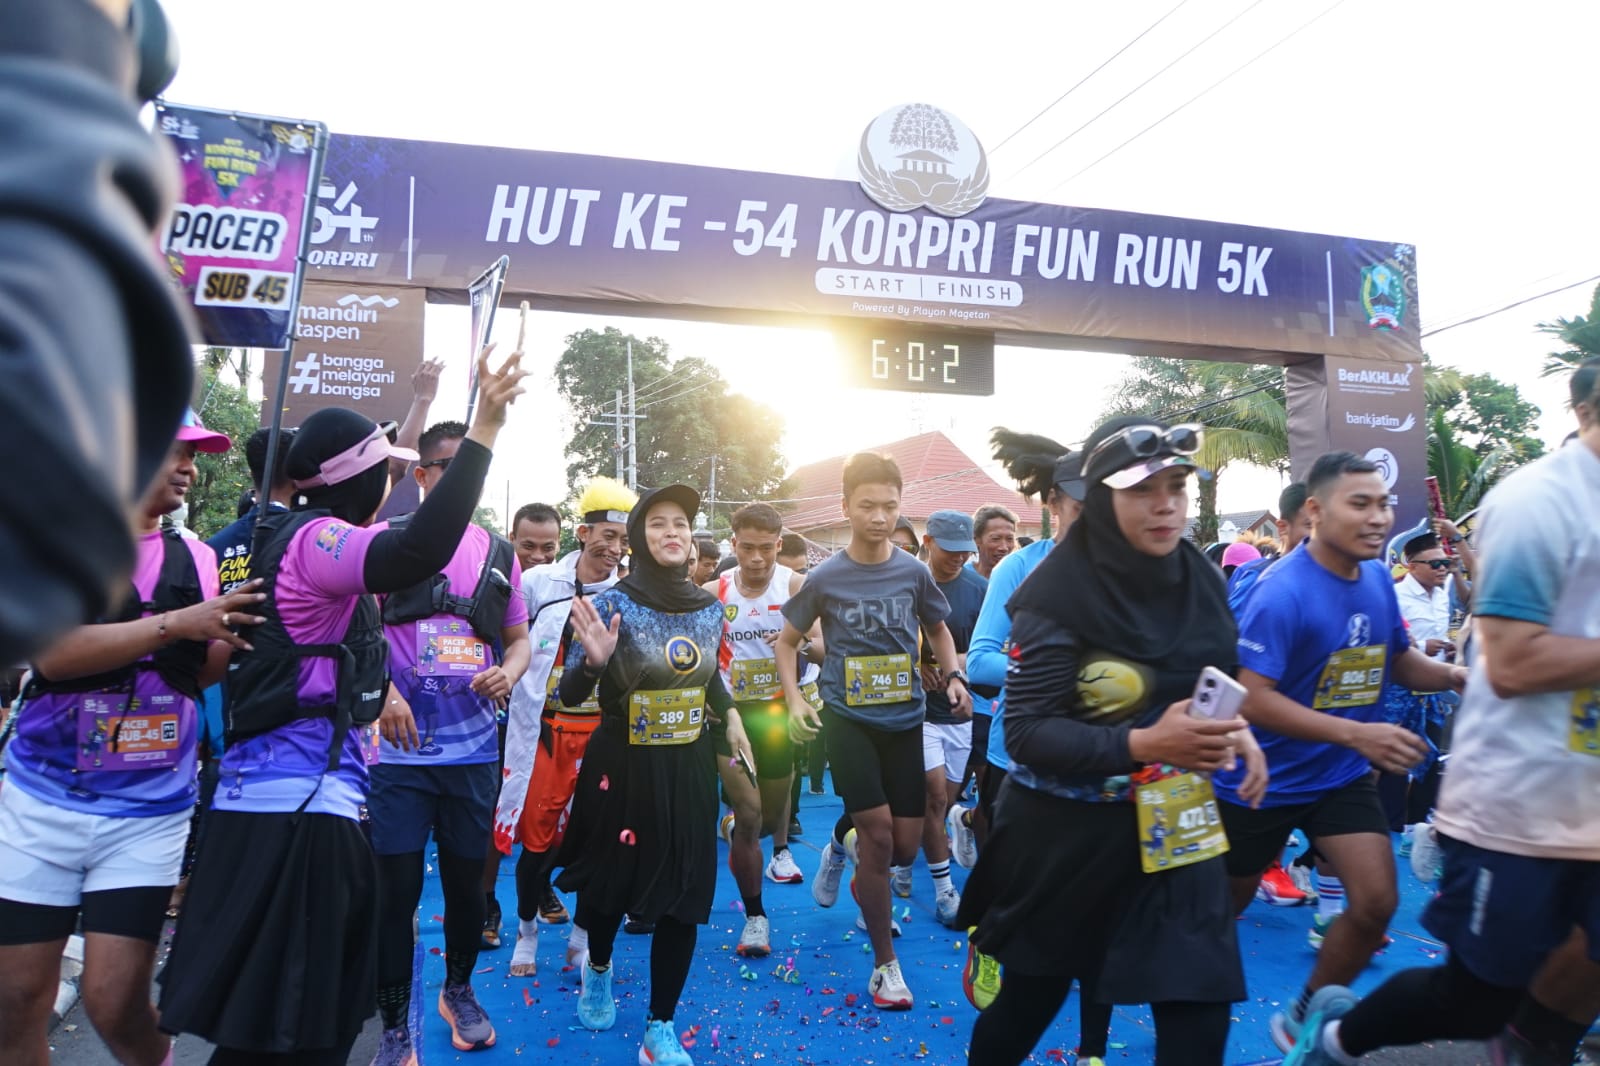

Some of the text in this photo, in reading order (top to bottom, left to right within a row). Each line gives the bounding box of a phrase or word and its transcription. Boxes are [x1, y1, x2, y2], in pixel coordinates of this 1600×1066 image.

[167, 210, 280, 254] PACER
[486, 184, 601, 246] HUT
[612, 192, 688, 252] KE
[816, 207, 997, 274] KORPRI
[1010, 223, 1100, 282] FUN
[1113, 233, 1202, 291] RUN
[1216, 242, 1274, 297] 5K
[307, 249, 379, 268] ORPRI
[203, 272, 289, 303] SUB 45
[835, 274, 1012, 301] START FINISH
[297, 304, 377, 323] mandiri
[852, 301, 991, 321] Powered By Playan Magetan
[296, 322, 360, 342] taspen
[322, 354, 384, 371] bangga
[322, 369, 395, 386] melayani
[1337, 366, 1411, 386] BerAKHLAK
[321, 382, 381, 400] bangsa
[1346, 411, 1400, 428] bankjatim
[218, 554, 252, 573] FUN
[221, 567, 251, 584] RUN
[442, 638, 466, 647] PACER
[442, 646, 474, 656] SUB-45
[423, 678, 439, 691] 54
[753, 673, 773, 685] 520
[871, 674, 893, 687] 746
[659, 710, 685, 725] 389
[117, 728, 160, 743] SUB-45
